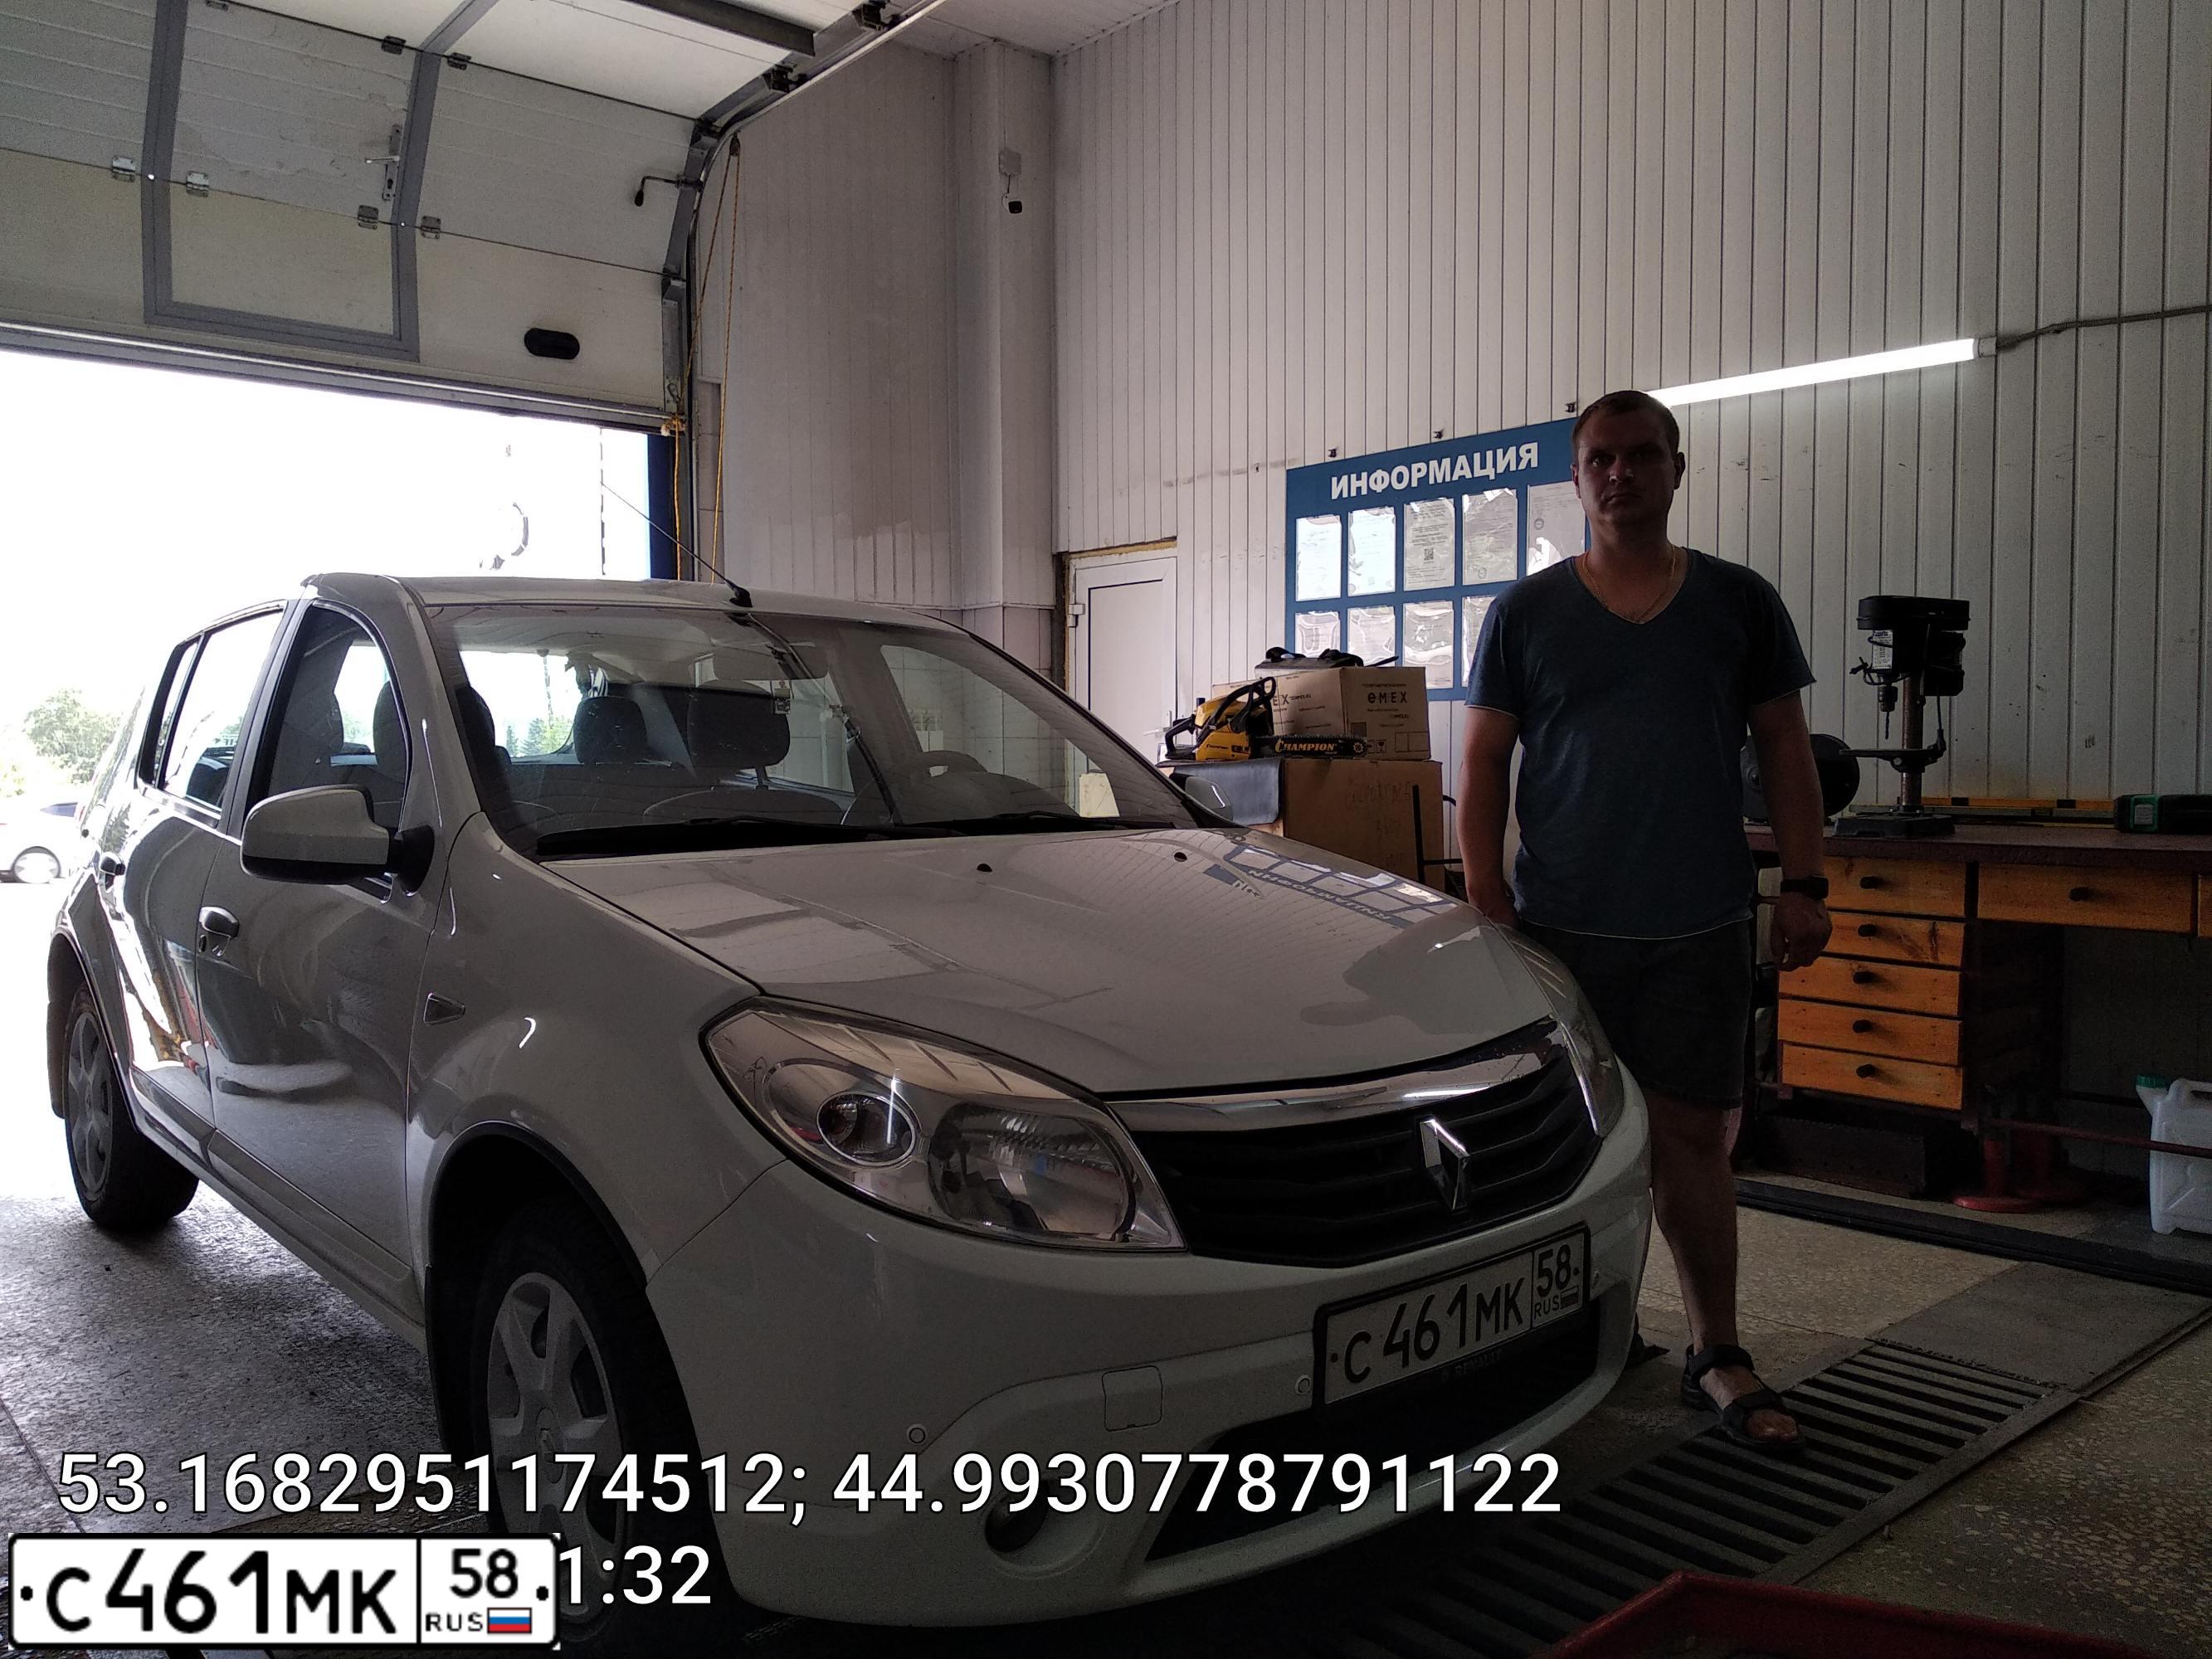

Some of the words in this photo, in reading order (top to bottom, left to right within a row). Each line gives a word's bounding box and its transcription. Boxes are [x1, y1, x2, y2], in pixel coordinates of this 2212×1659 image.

[1330, 441, 1539, 500] ИНФОРМАЦИЯ
[1274, 737, 1335, 753] CHAMPION
[1537, 1244, 1571, 1298] 58
[1534, 1298, 1561, 1318] RUS
